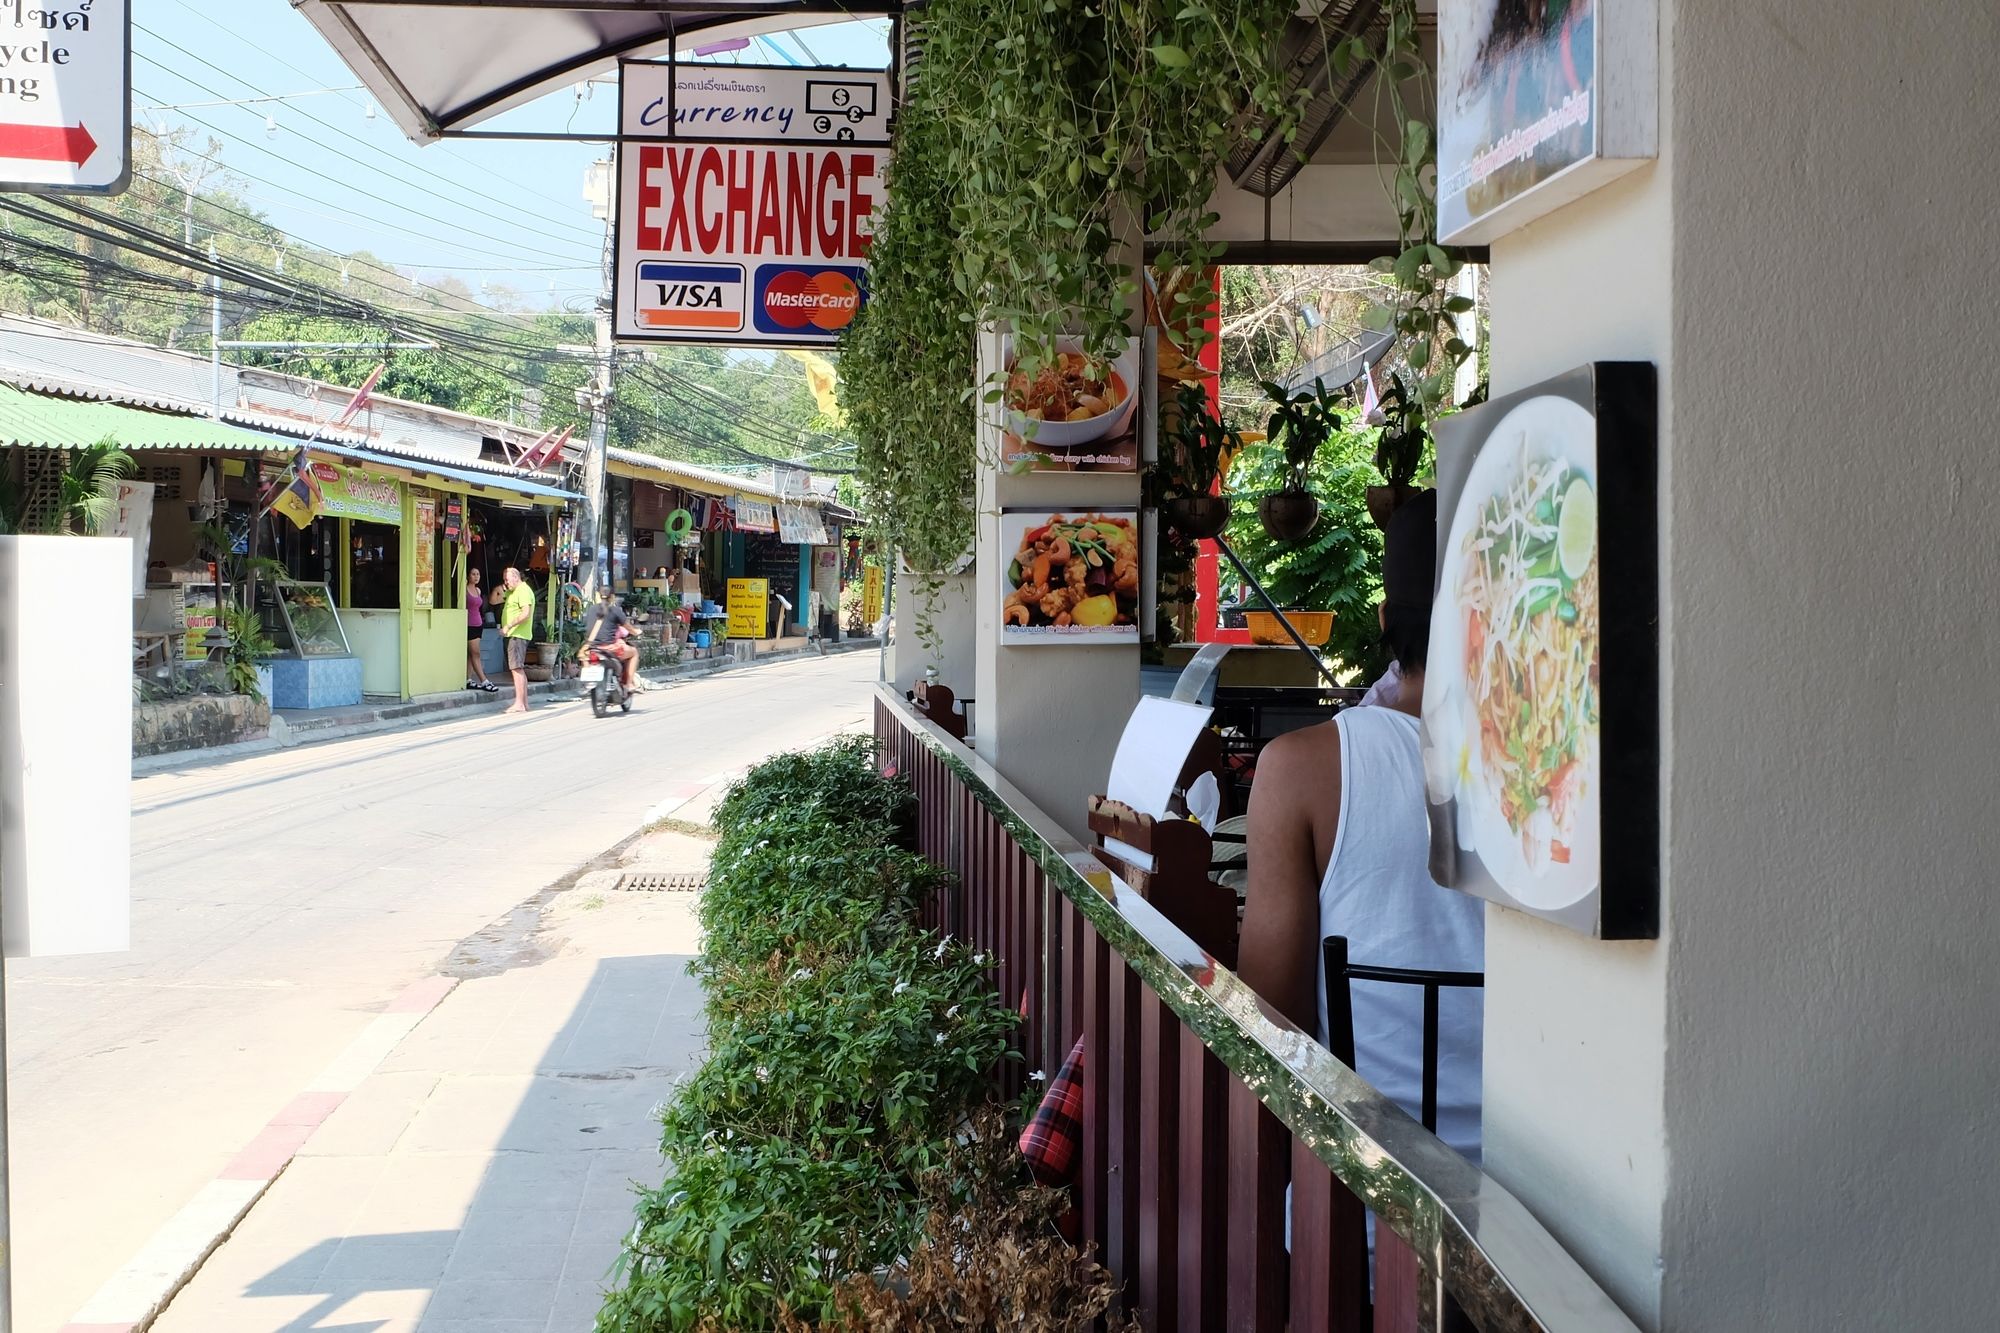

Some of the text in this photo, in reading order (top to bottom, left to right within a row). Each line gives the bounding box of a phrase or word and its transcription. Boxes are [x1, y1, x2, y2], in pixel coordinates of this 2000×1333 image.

[673, 77, 766, 93] ลกเปลี่ยนเงินตรา
[640, 96, 794, 134] Currency
[637, 146, 875, 259] EXCHANGE
[656, 284, 723, 308] VISA
[766, 291, 858, 310] MasterCard
[1082, 454, 1095, 463] with
[1096, 455, 1119, 463] chicken
[1120, 455, 1131, 465] leg
